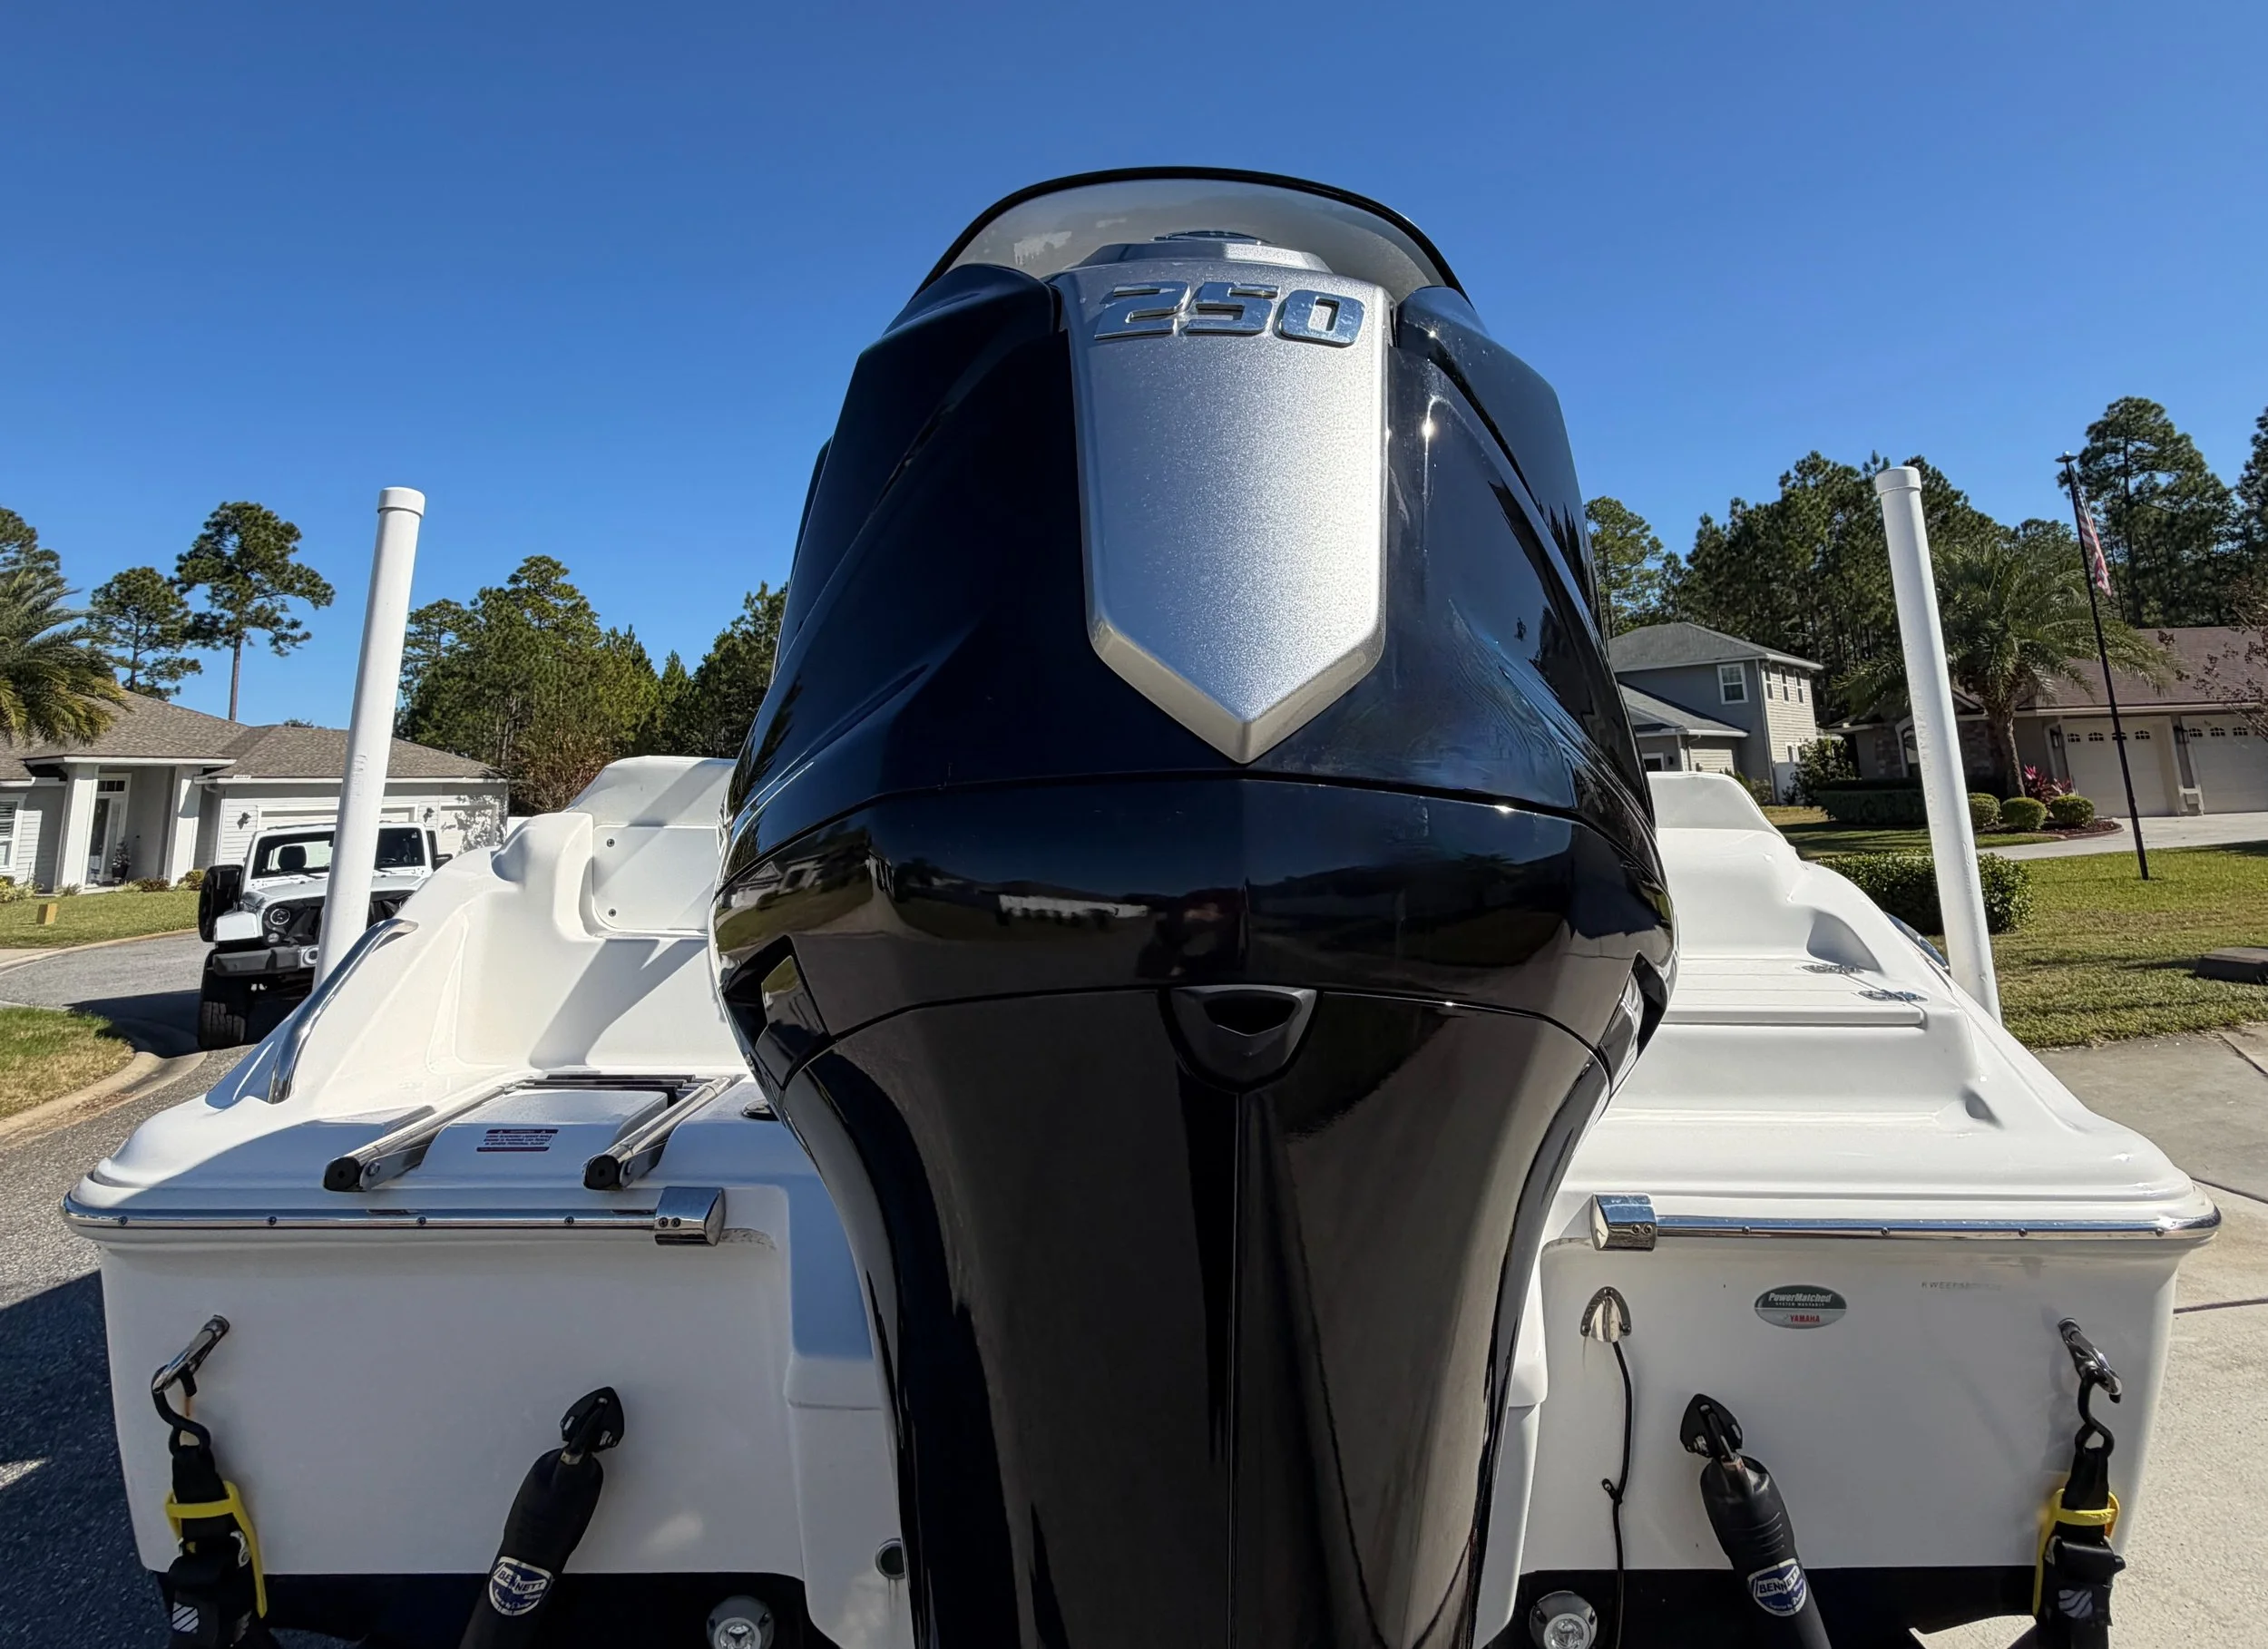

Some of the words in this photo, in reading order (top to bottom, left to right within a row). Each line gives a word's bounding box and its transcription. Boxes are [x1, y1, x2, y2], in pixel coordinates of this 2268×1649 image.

[1093, 280, 1366, 348] 250
[1768, 1293, 1832, 1303] PowerMatched
[1790, 1313, 1821, 1322] YAMAHA
[497, 1570, 544, 1592] BENNETT
[1759, 1569, 1799, 1594] BENNETT
